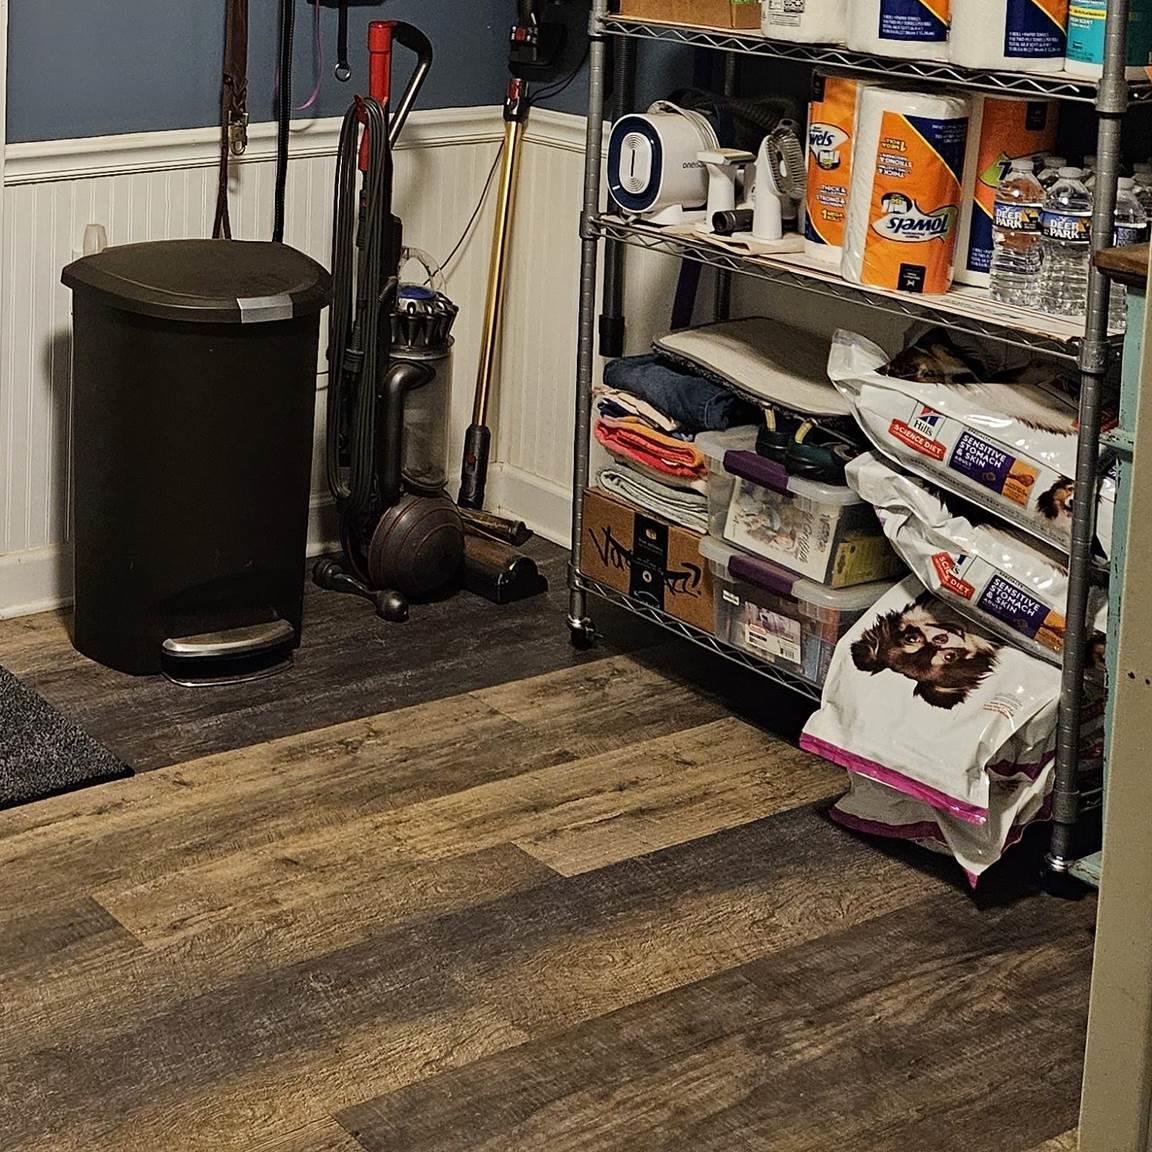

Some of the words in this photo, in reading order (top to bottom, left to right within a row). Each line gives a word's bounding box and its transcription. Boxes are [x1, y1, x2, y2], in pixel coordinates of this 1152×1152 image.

[887, 214, 949, 235] Towels
[995, 209, 1022, 220] DEER
[995, 217, 1023, 229] PARK
[1050, 220, 1077, 230] DEER
[1049, 228, 1080, 240] PARK
[894, 424, 924, 445] SCIENCE
[924, 439, 943, 454] DIET
[962, 434, 1007, 462] SENSITIVE
[956, 449, 963, 457] &
[964, 452, 986, 468] SKIN
[959, 441, 1002, 468] STOMACH
[950, 578, 970, 595] DIET
[993, 578, 1041, 612] SENSITIVE
[985, 592, 993, 601] &
[995, 597, 1018, 614] SKIN
[989, 584, 1036, 617] STOMACH
